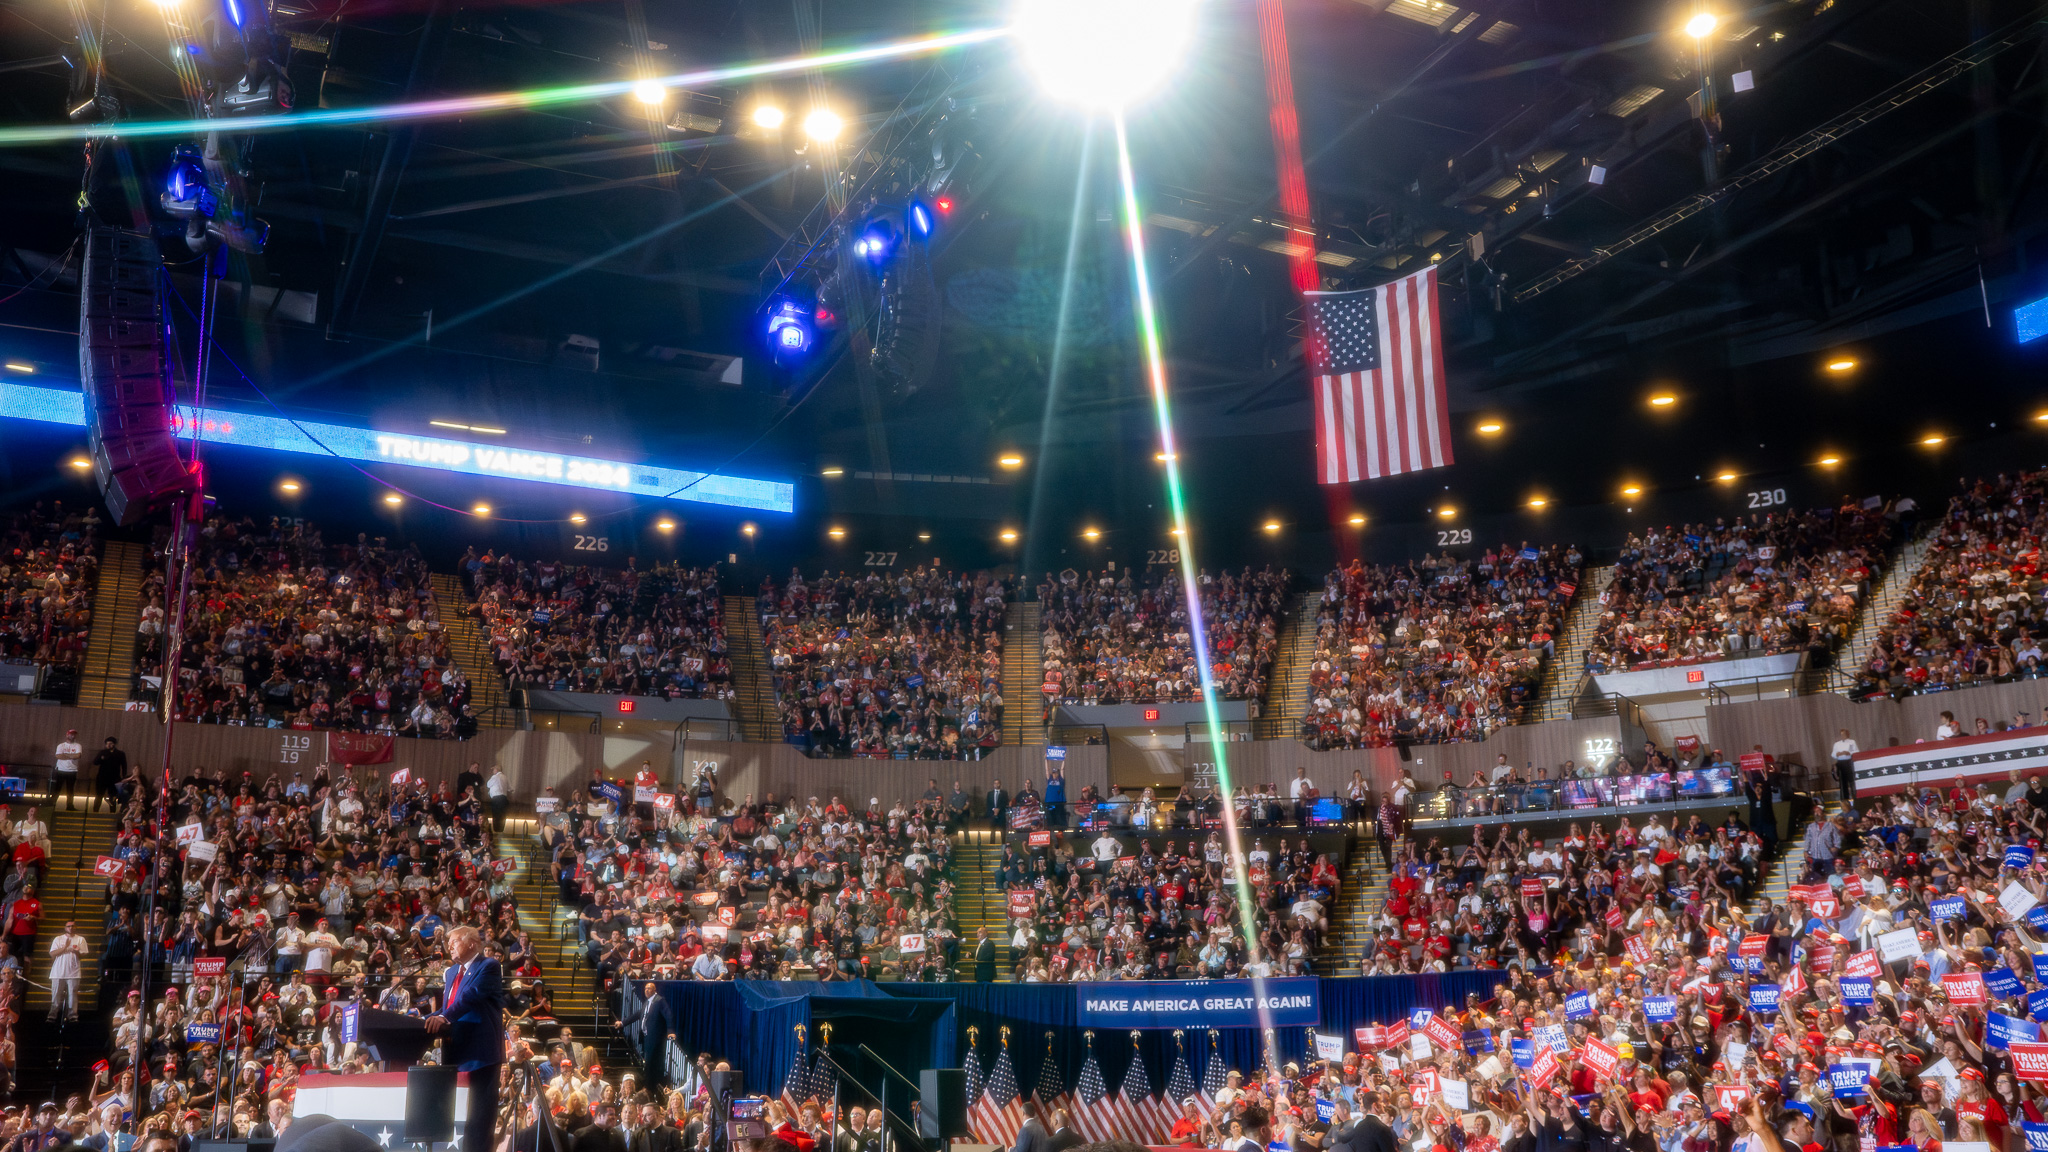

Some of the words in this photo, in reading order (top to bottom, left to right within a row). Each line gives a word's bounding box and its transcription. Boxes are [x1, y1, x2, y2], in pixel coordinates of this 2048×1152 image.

[378, 436, 469, 465] TRUMP
[475, 449, 562, 477] VANCE
[567, 461, 630, 486] 2024
[1748, 488, 1786, 509] 230
[574, 535, 608, 552] 226
[1437, 529, 1472, 546] 229
[864, 552, 897, 566] 227
[1147, 550, 1180, 565] 228
[1689, 671, 1701, 681] EXIT
[620, 701, 633, 712] EXIT
[1145, 710, 1157, 720] EXIT
[281, 735, 310, 749] 119
[1586, 739, 1613, 752] 122
[280, 751, 299, 763] 19
[1193, 763, 1218, 774] 121
[392, 771, 407, 784] 47
[1194, 777, 1210, 788] 21
[603, 784, 620, 794] TRUMP
[655, 795, 673, 806] 47
[180, 824, 201, 841] 47
[99, 859, 124, 874] 47
[495, 859, 513, 872] 47
[1812, 900, 1835, 917] 47
[1932, 902, 1964, 912] TRUMP
[903, 937, 921, 949] 47
[196, 961, 225, 969] TRUMP
[1846, 953, 1873, 969] DRAIN
[1783, 968, 1799, 993] 47
[1944, 981, 1980, 990] TRUMP
[1751, 990, 1779, 998] TRUMP
[1948, 988, 1977, 996] VANCE
[1086, 1000, 1128, 1011] MAKE
[1132, 999, 1199, 1011] AMERICA
[1204, 998, 1254, 1010] GREAT
[1258, 996, 1311, 1009] AGAIN!
[1566, 996, 1587, 1005] TRUMP
[1567, 1002, 1586, 1011] VANCE
[1413, 1010, 1432, 1026] 47
[190, 1026, 219, 1034] TRUMP
[1431, 1020, 1457, 1041] TRUMP
[2006, 1027, 2035, 1040] AMERICA
[1545, 1032, 1566, 1043] SAFE
[1587, 1043, 1616, 1063] TRUMP
[1588, 1051, 1611, 1068] VANCE
[1831, 1070, 1868, 1081] TRUMP
[1834, 1078, 1862, 1087] VANCE
[1413, 1087, 1429, 1106] 47
[1721, 1090, 1747, 1114] 47
[1317, 1104, 1336, 1112] TRUM
[2025, 1130, 2048, 1141] TRU
